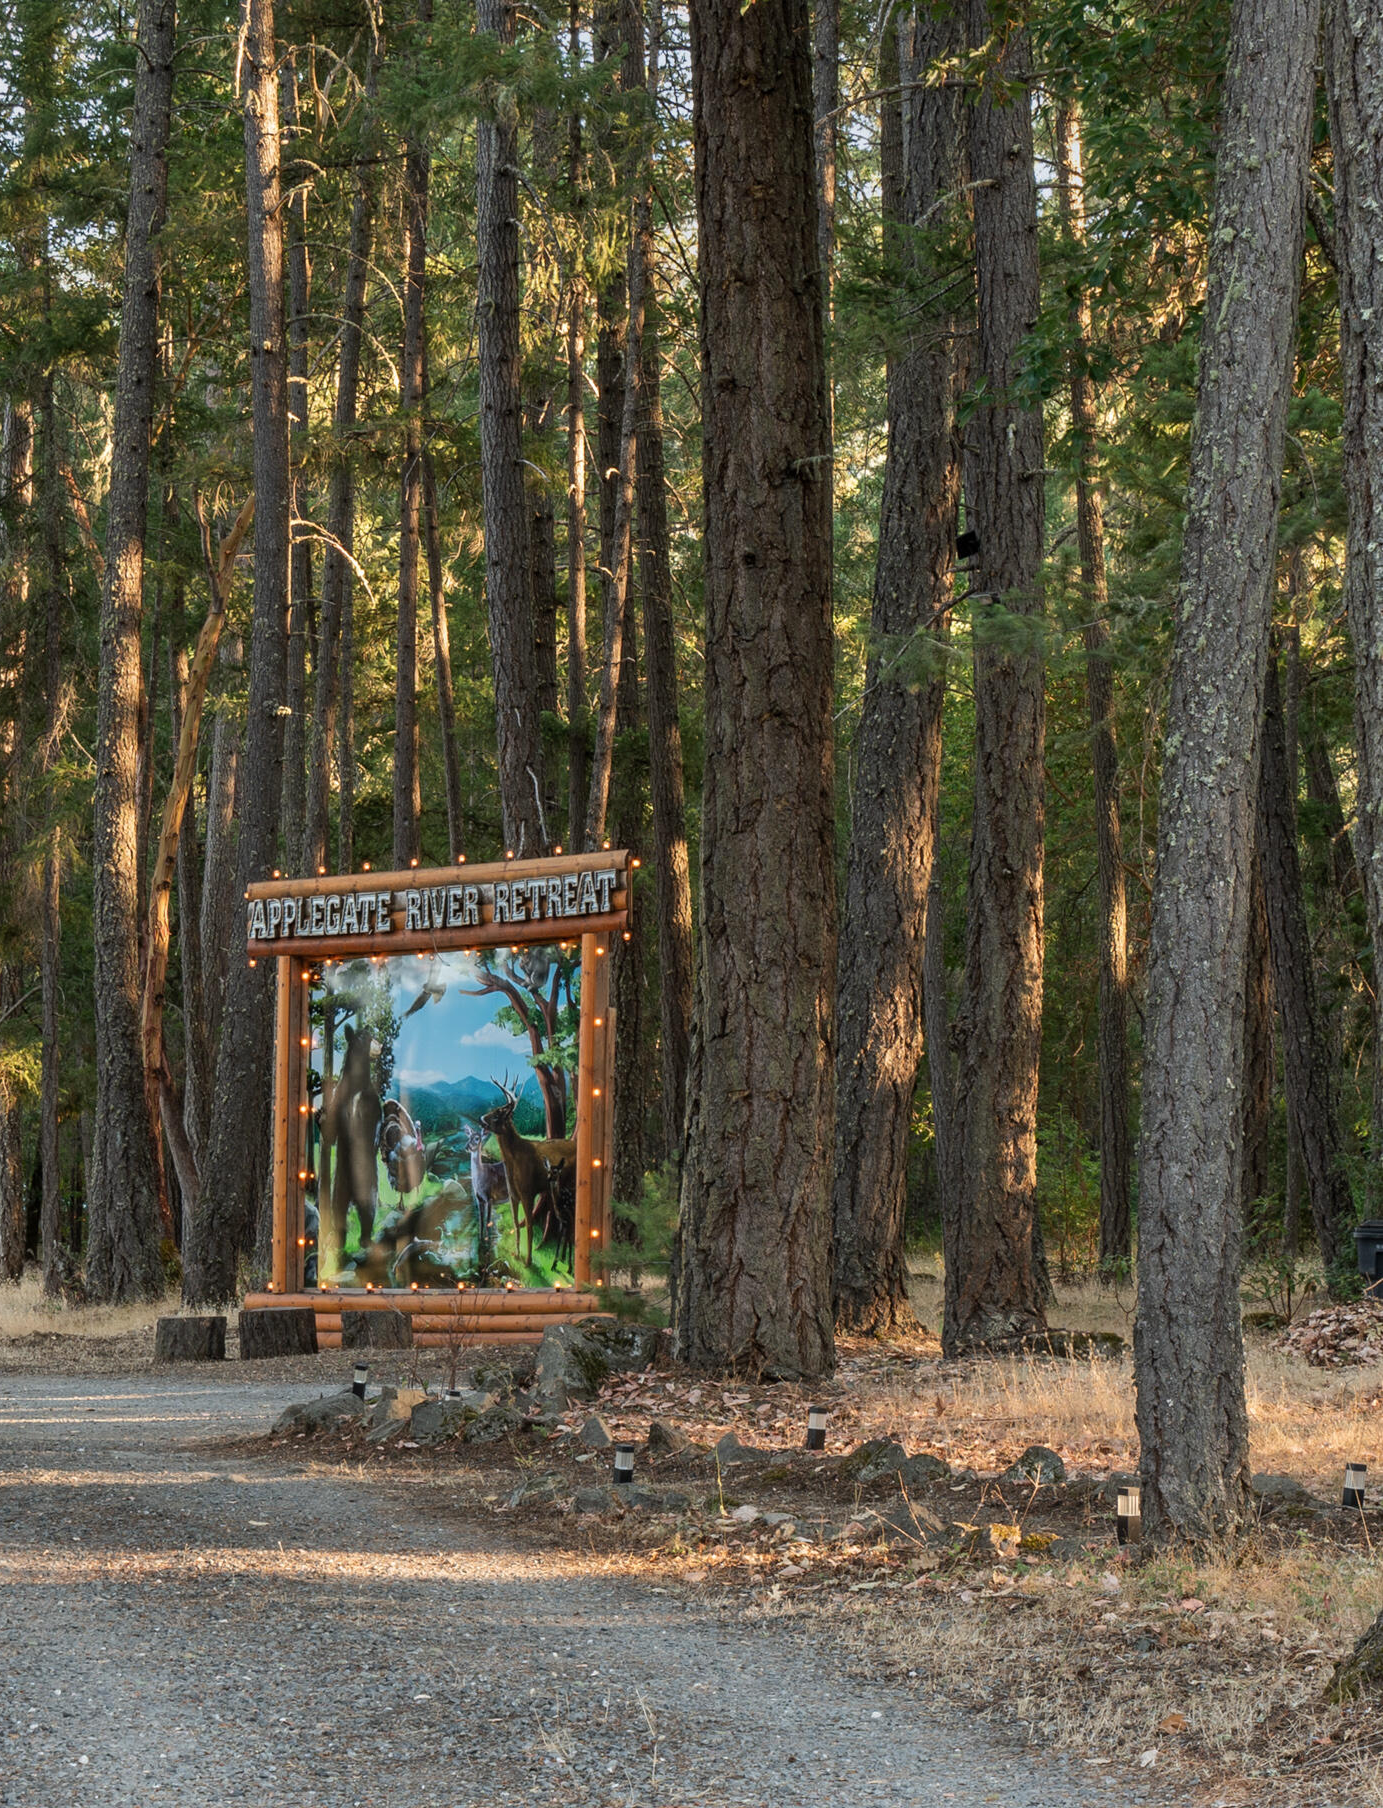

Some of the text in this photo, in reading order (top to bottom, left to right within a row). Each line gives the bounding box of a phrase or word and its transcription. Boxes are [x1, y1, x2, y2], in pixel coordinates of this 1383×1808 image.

[248, 869, 617, 939] APPLEGATE RIVER RETREAT
